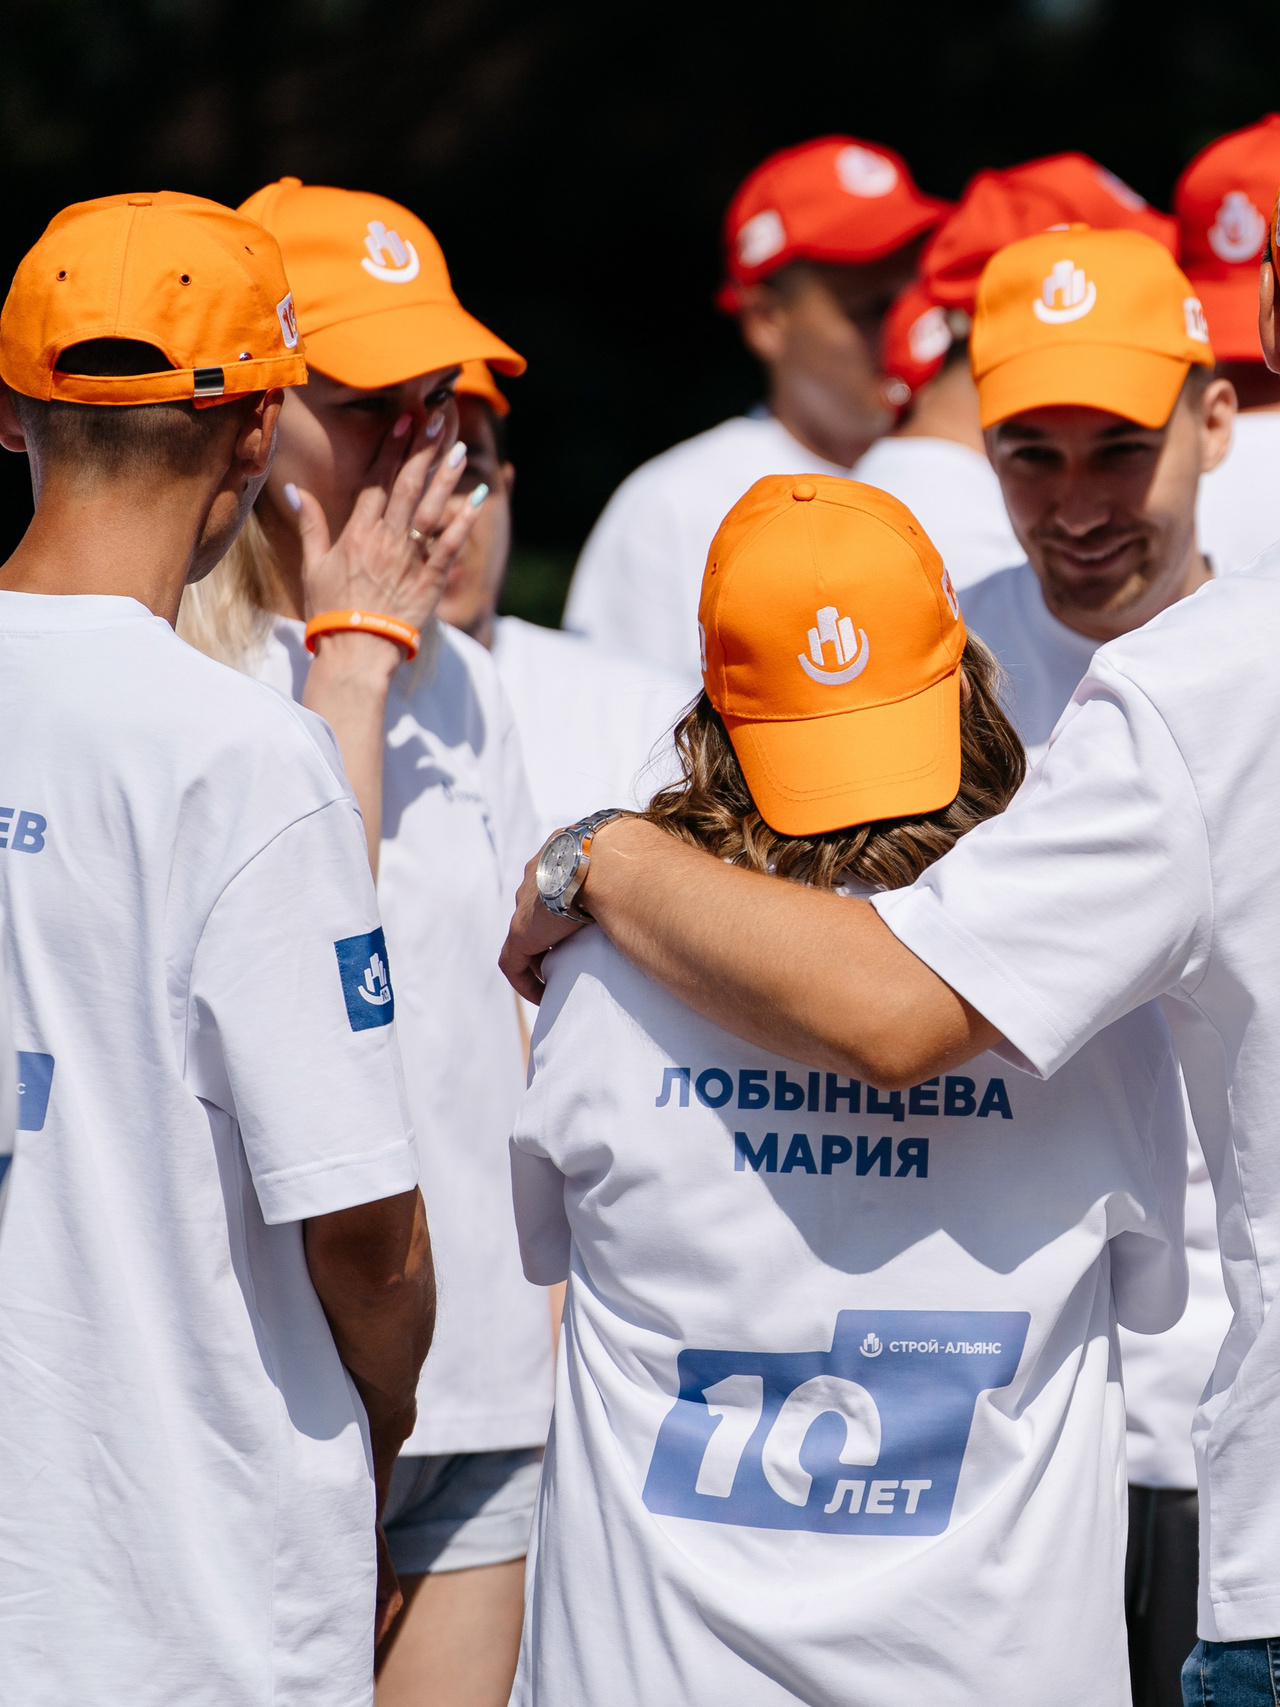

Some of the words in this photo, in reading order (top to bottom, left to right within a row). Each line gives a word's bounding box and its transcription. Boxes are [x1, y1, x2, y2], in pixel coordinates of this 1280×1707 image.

[655, 1067, 1014, 1123] ЛОБЫНЦЕВА
[733, 1131, 930, 1179] МАРИЯ
[889, 1339, 1002, 1355] СТРОЙ-АЛЬЯНС
[694, 1374, 882, 1507] 10
[823, 1479, 932, 1514] ЛЕТ
